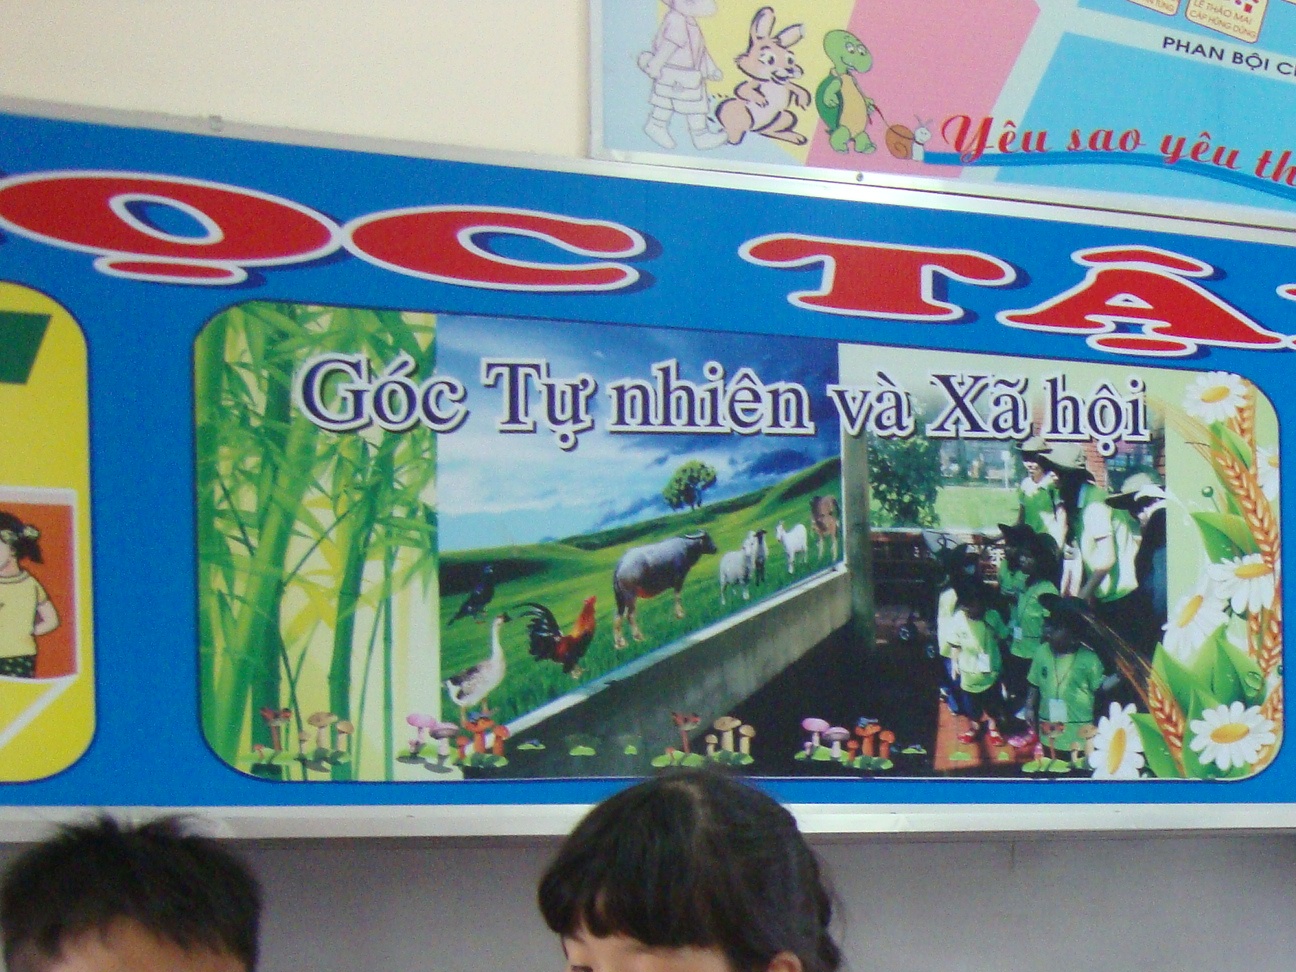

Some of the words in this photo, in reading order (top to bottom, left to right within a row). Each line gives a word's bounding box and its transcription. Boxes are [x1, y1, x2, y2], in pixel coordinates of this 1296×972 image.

[1162, 36, 1225, 61] PHAN
[1232, 51, 1270, 71] BỘI
[941, 114, 1052, 163] Yêu
[1065, 126, 1146, 154] sao
[1159, 131, 1242, 171] yêu
[290, 350, 469, 435] Góc
[483, 354, 595, 453] Tự
[605, 357, 819, 438] nhiên
[827, 367, 917, 441] và
[926, 369, 1032, 443] Xã
[1040, 368, 1151, 459] hội
